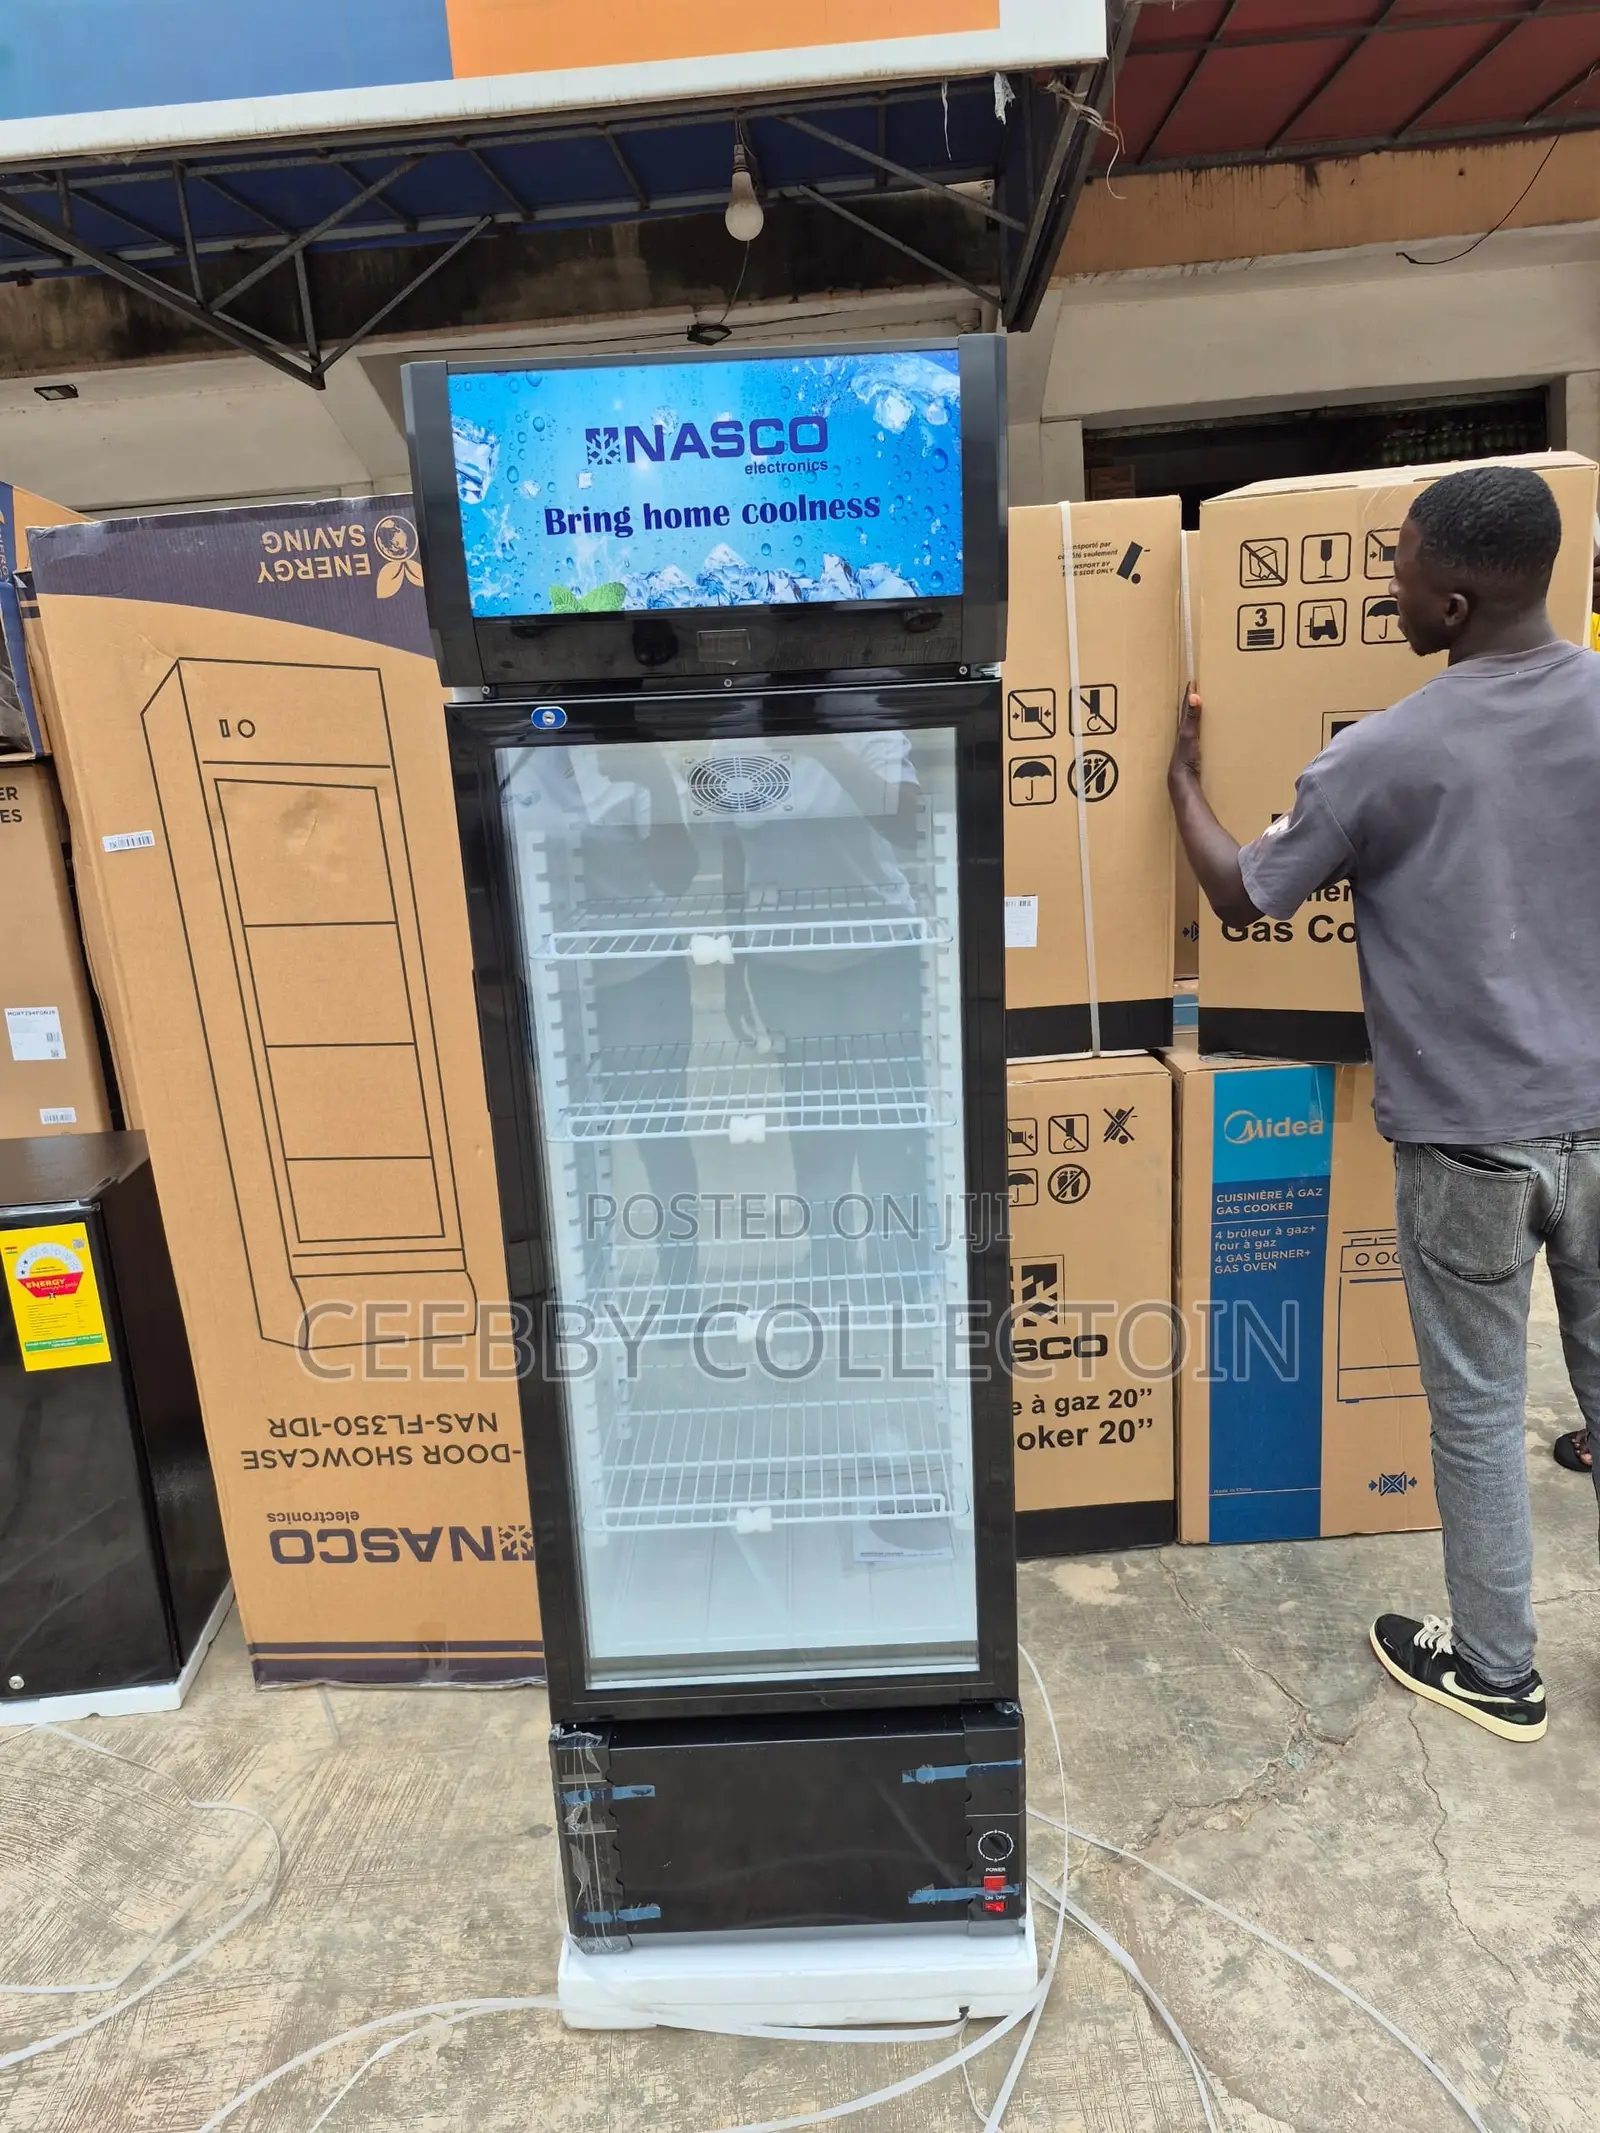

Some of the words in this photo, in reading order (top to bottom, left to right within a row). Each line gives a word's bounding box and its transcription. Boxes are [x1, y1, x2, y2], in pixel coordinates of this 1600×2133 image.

[625, 416, 829, 463] NASCO
[744, 458, 828, 475] electronics
[544, 505, 634, 538] Bring
[643, 500, 731, 531] home
[741, 493, 881, 526] coolness
[261, 524, 367, 554] SAVING
[1099, 541, 1111, 549] par
[257, 553, 371, 584] ENERGY
[1254, 608, 1268, 627] 3
[1223, 1109, 1324, 1145] Midea
[1216, 1190, 1282, 1203] CUISINIÈRE
[1285, 1187, 1294, 1198] À
[1297, 1188, 1323, 1197] GAZ
[1216, 1205, 1240, 1215] GAS
[1243, 1202, 1293, 1213] COOKER
[1215, 1231, 1222, 1239] 4
[1227, 1228, 1271, 1239] brûleur
[1275, 1226, 1282, 1235] à
[1286, 1225, 1316, 1237] gaz+
[1215, 1241, 1239, 1251] four
[1243, 1239, 1250, 1249] à
[1254, 1239, 1276, 1249] gaz
[1215, 1255, 1222, 1263] 4
[1226, 1252, 1250, 1263] GAS
[1254, 1249, 1311, 1260] BURNER+
[1214, 1264, 1239, 1274] GAS
[1243, 1261, 1277, 1272] OVEN
[1031, 1394, 1046, 1414] à
[1054, 1395, 1100, 1417] gaz
[267, 1412, 499, 1438] NAS-FL350-1DR
[1016, 1425, 1089, 1451] oker
[240, 1445, 413, 1470] SHOWCASE
[266, 1510, 360, 1523] electronics
[269, 1525, 496, 1565] NASCO
